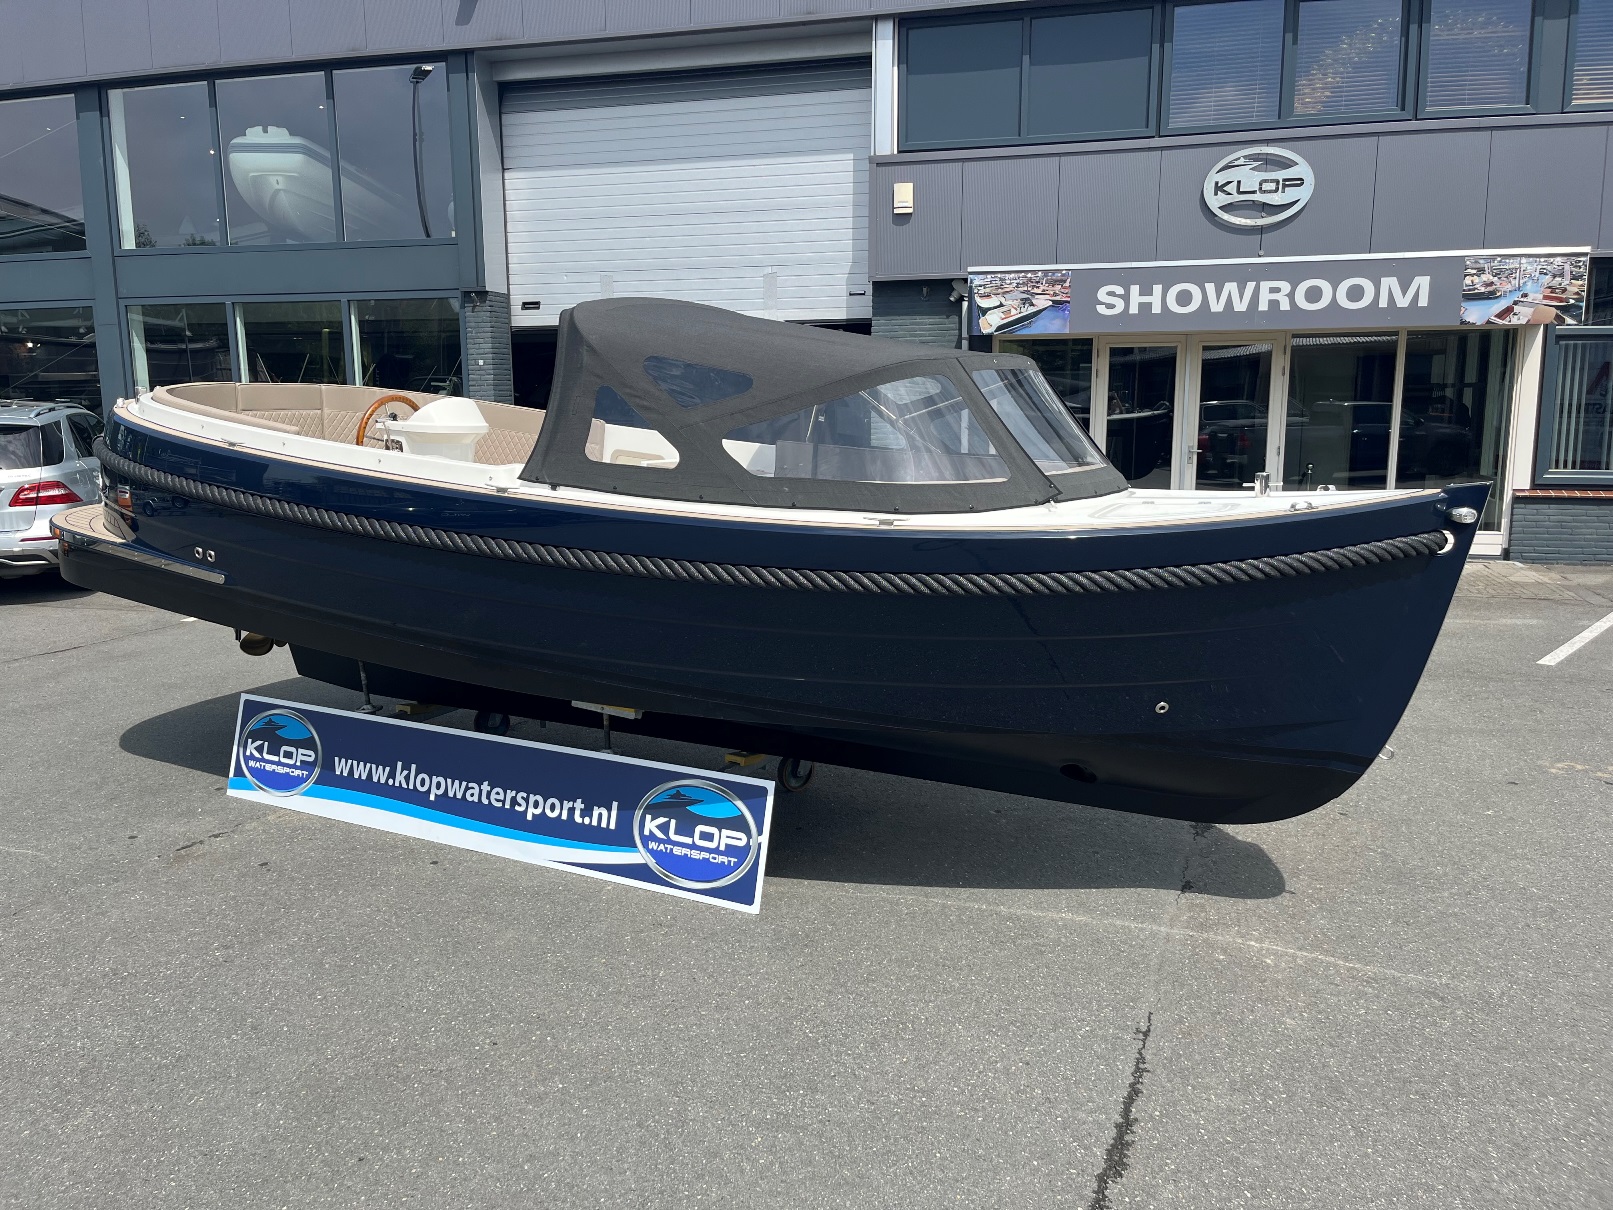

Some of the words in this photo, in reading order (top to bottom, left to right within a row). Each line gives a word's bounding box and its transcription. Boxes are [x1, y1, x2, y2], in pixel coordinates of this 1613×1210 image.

[1213, 177, 1305, 197] KLOP
[1095, 275, 1431, 316] SHOWROOM
[245, 738, 316, 766] KLOP
[248, 760, 309, 778] WATERSPORT
[334, 756, 618, 830] www.klopwatersport.nl
[643, 814, 748, 851] KLOP
[648, 841, 738, 866] WATERSPORT
